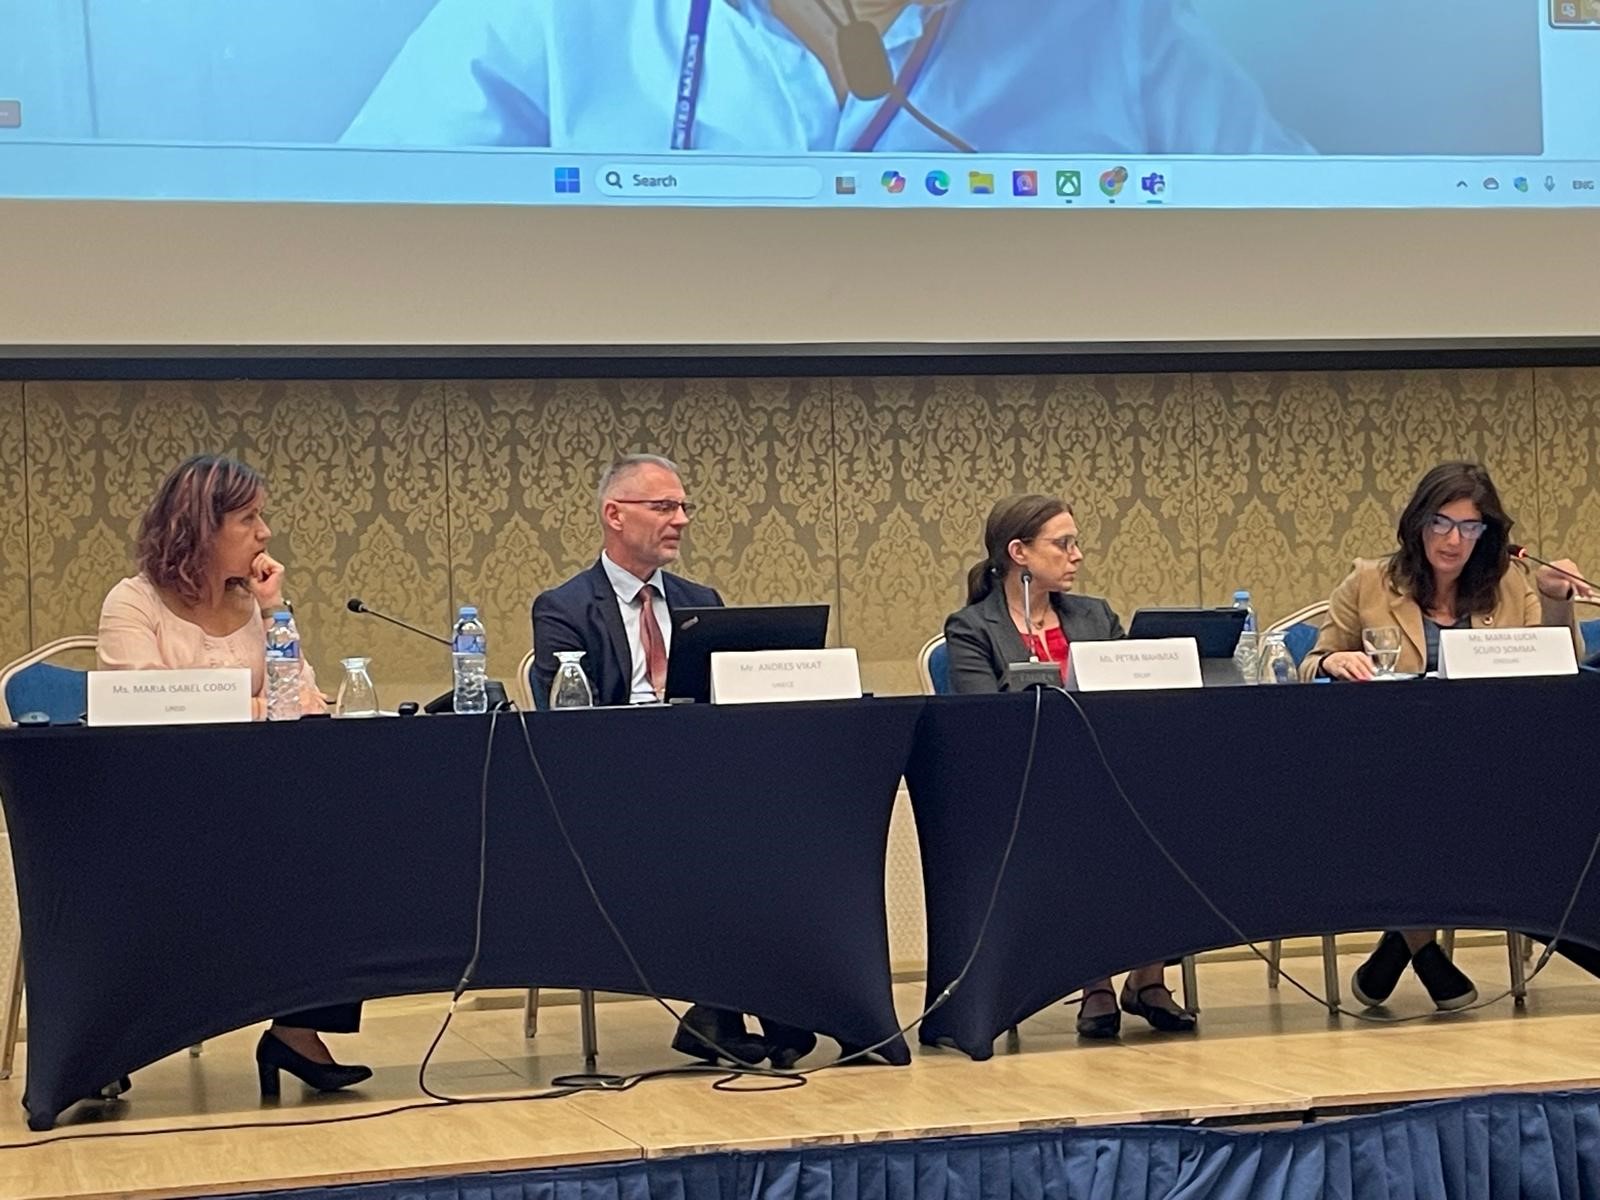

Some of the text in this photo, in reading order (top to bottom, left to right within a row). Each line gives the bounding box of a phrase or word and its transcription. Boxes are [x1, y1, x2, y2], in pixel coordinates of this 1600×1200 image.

[632, 173, 677, 188] Search
[1572, 179, 1594, 190] ENG
[1485, 633, 1512, 641] MARIA
[758, 662, 794, 671] ANDRES
[112, 682, 237, 694] Ms. MARIA ISABEL COBOS
